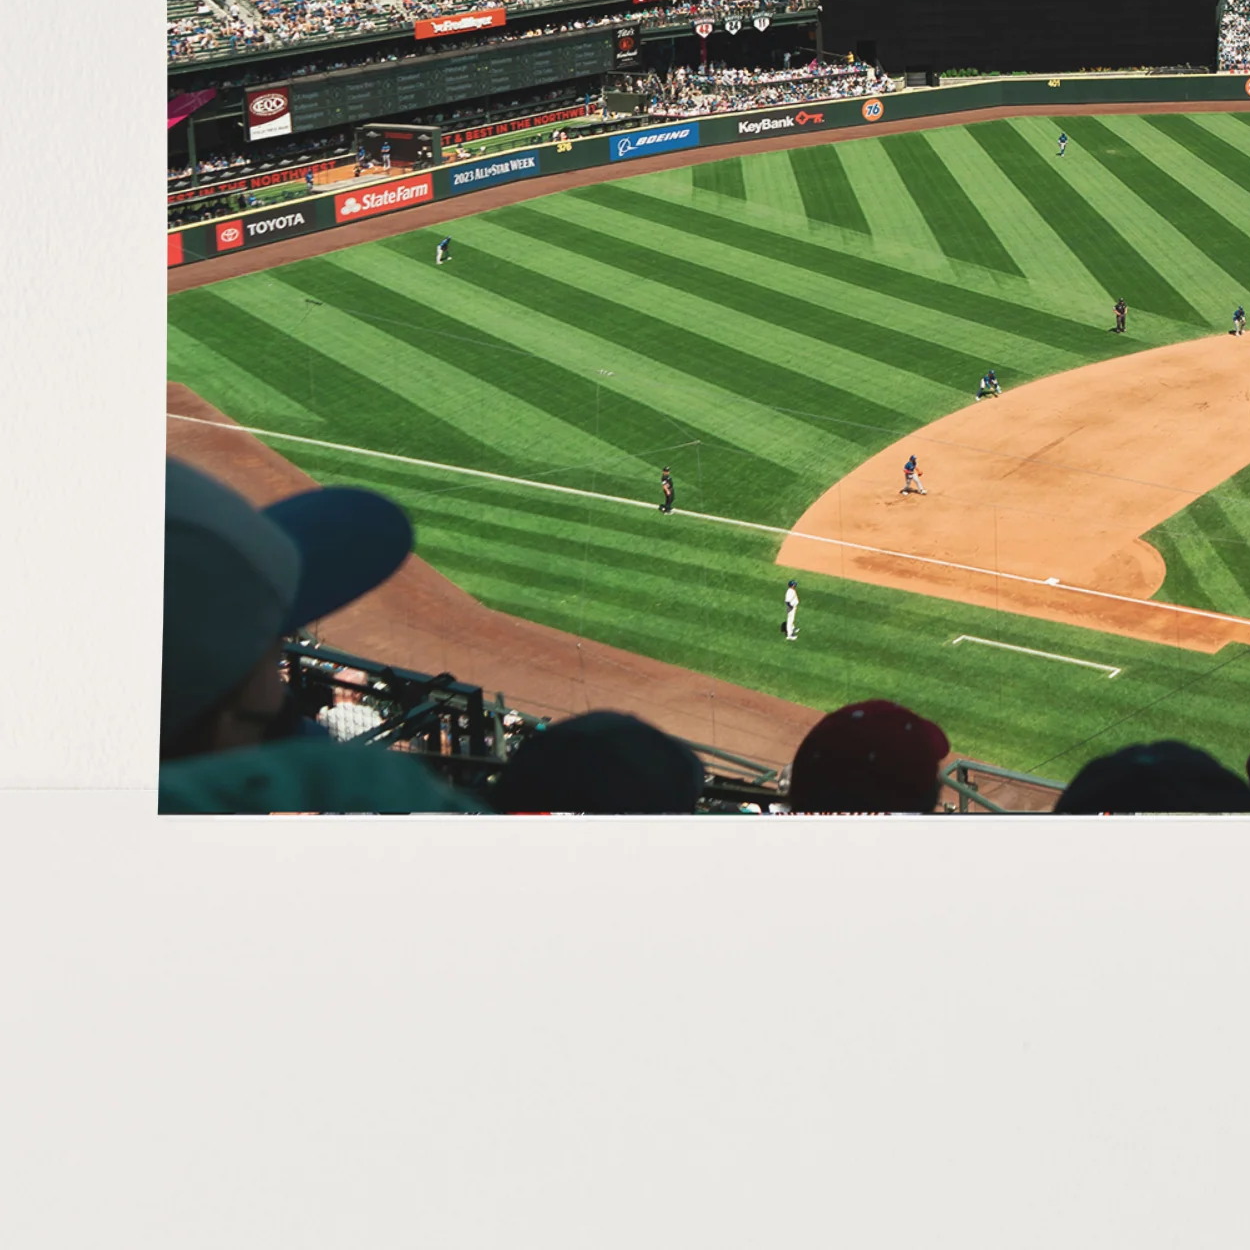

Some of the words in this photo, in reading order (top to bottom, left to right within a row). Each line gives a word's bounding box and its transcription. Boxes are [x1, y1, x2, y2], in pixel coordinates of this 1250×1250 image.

[729, 21, 739, 31] 24
[1047, 79, 1061, 88] 401
[253, 97, 285, 113] EQC
[865, 104, 882, 117] 76
[465, 126, 494, 141] BEST
[496, 123, 509, 135] IN
[511, 117, 532, 131] THE
[534, 104, 598, 127] NORTHWET
[738, 116, 794, 136] KeyBank
[636, 129, 691, 147] BOEING
[250, 161, 338, 191] NORTHWEST
[453, 169, 475, 186] 2023
[510, 156, 536, 173] WEEK
[246, 213, 305, 236] TOYOTA
